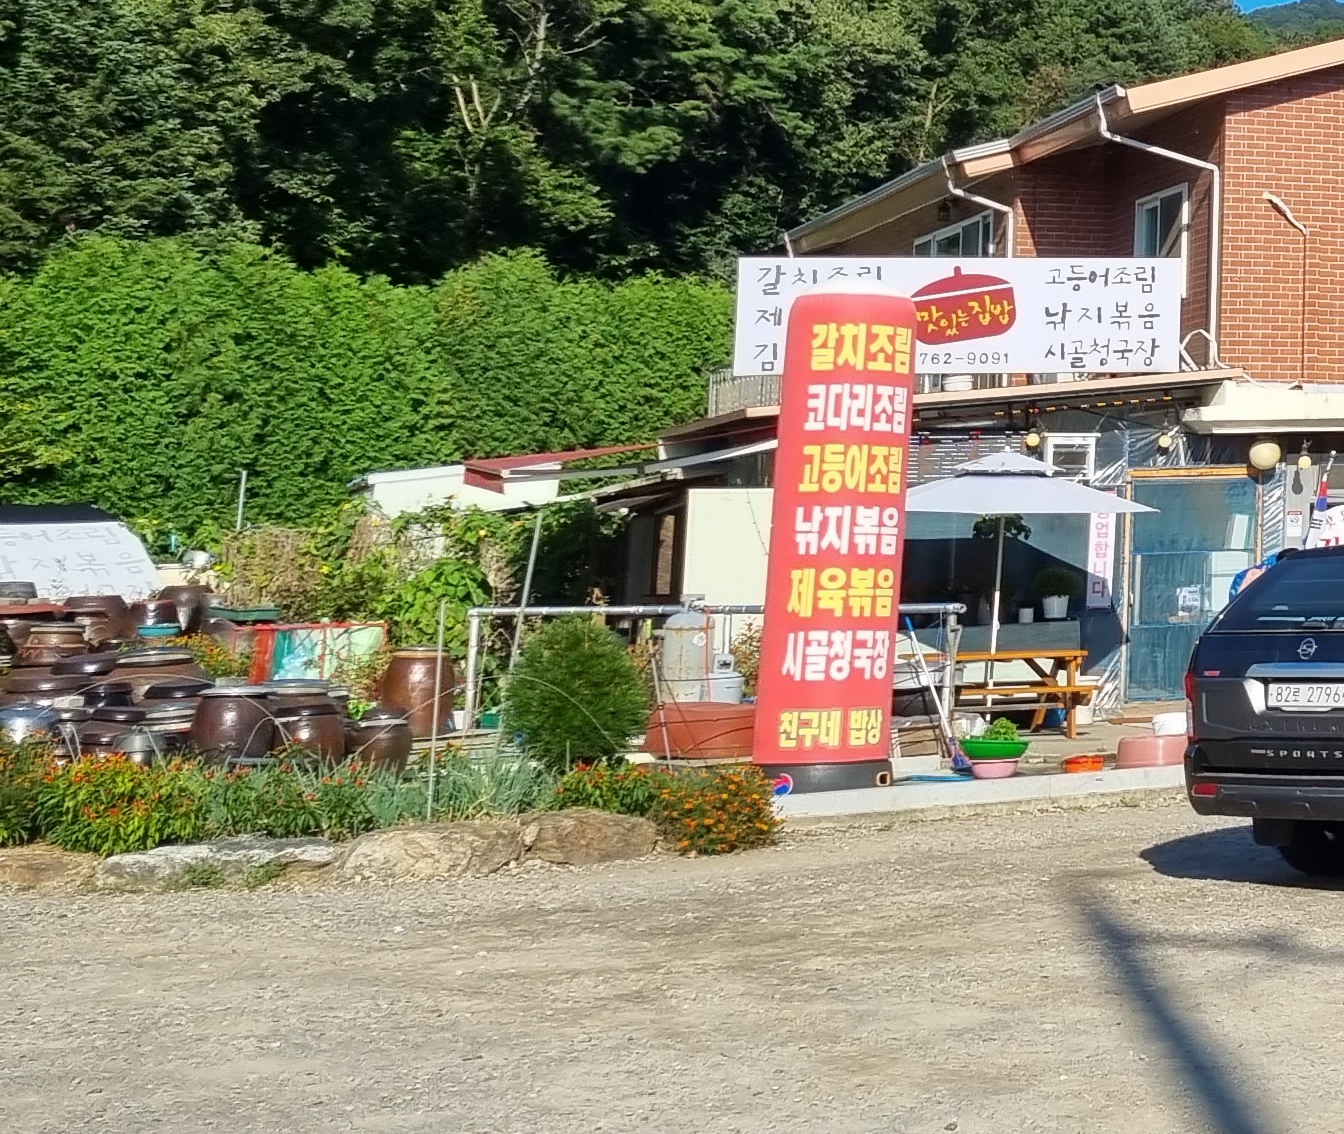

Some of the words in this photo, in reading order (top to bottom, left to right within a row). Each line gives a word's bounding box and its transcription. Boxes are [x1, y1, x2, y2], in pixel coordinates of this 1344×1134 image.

[1045, 265, 1156, 294] 고등어조림
[811, 322, 912, 374] 갈치조림
[919, 352, 1010, 365] 762-9091
[1045, 338, 1160, 369] 시골청국장
[804, 383, 908, 434] 코다리조림
[798, 443, 903, 494] 고등어조림
[795, 505, 899, 555] 낚지볶음
[787, 567, 895, 617] 제육볶음
[781, 629, 890, 681] 시골청국장
[1275, 686, 1300, 703] 82로
[1307, 686, 1341, 703] 2796
[778, 709, 841, 748] 친구네
[849, 708, 882, 746] 밥상
[1265, 750, 1344, 759] SPORTS
